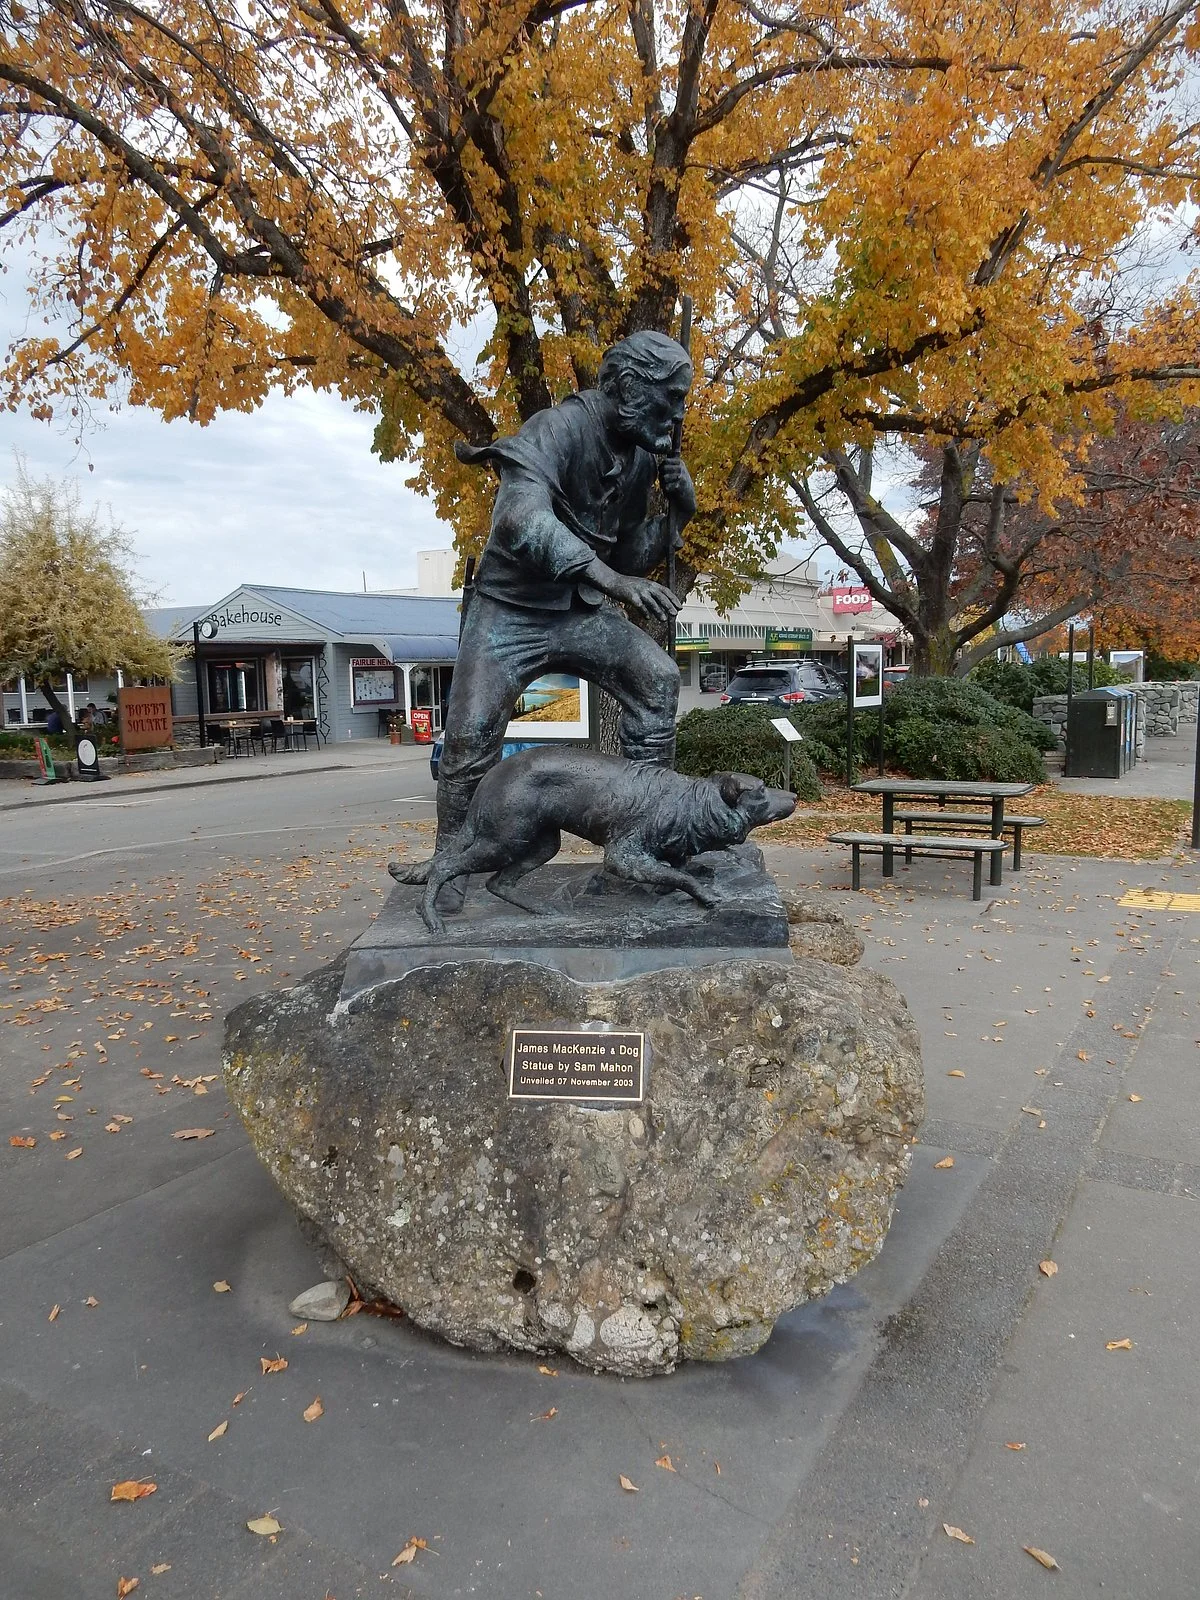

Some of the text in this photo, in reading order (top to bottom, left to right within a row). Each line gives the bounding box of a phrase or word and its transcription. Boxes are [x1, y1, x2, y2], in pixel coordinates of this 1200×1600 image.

[836, 594, 869, 605] FOOD
[211, 604, 281, 628] Bakehouse
[316, 652, 331, 744] BAKERY
[413, 712, 429, 720] OPEN
[127, 717, 168, 732] SQUARE
[517, 1043, 548, 1053] James
[552, 1043, 606, 1055] MacKenzie
[619, 1045, 639, 1058] Dog
[522, 1060, 633, 1072] Statue by Sam Mahon
[520, 1076, 633, 1087] Unveiled 07 November 2003
